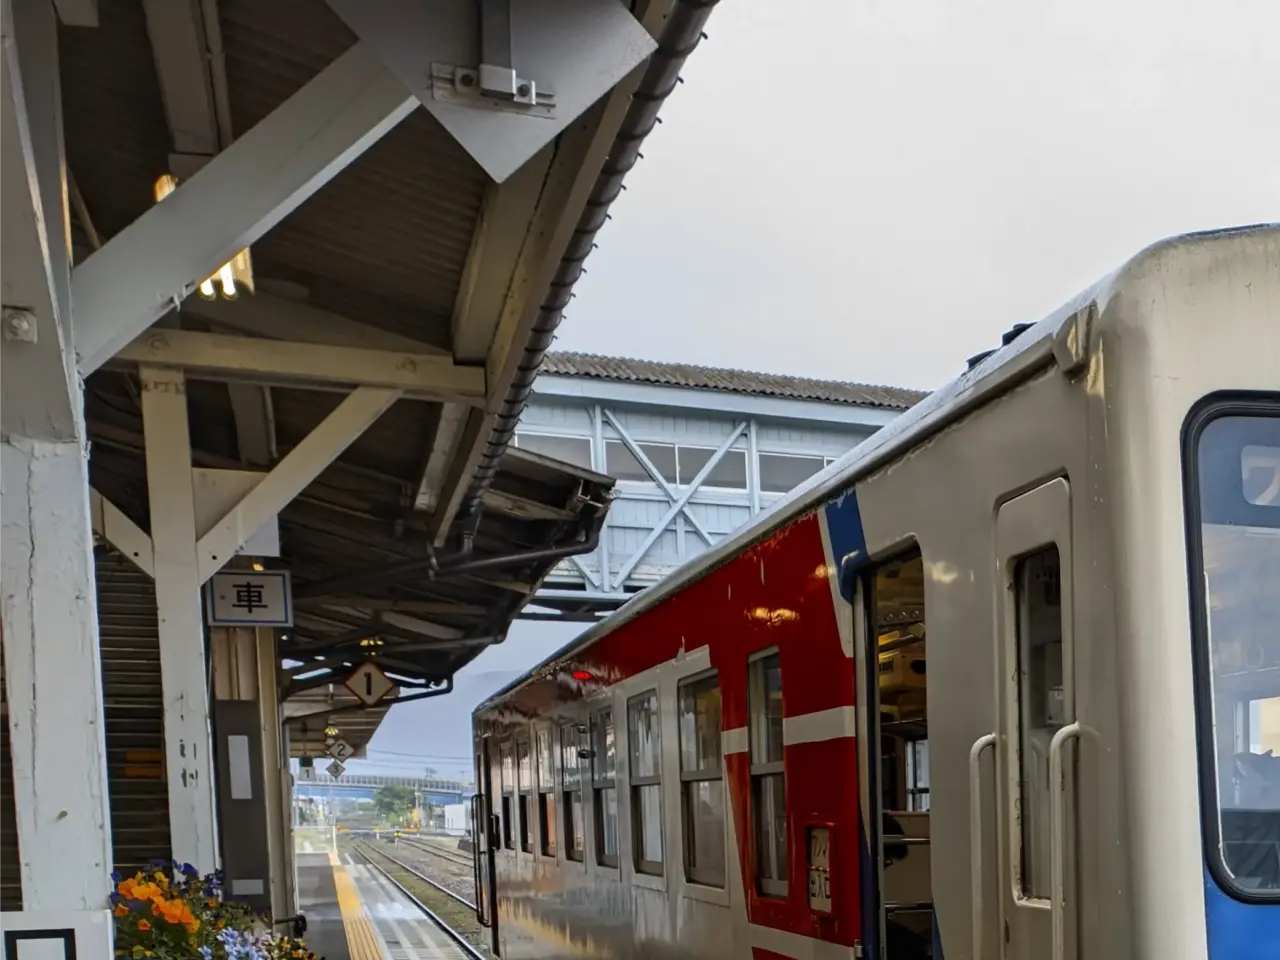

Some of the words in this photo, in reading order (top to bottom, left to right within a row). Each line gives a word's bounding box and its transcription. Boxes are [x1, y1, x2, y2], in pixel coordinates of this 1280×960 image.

[232, 582, 268, 614] 車
[364, 672, 372, 695] 1
[337, 743, 346, 757] 2
[332, 764, 339, 774] 3
